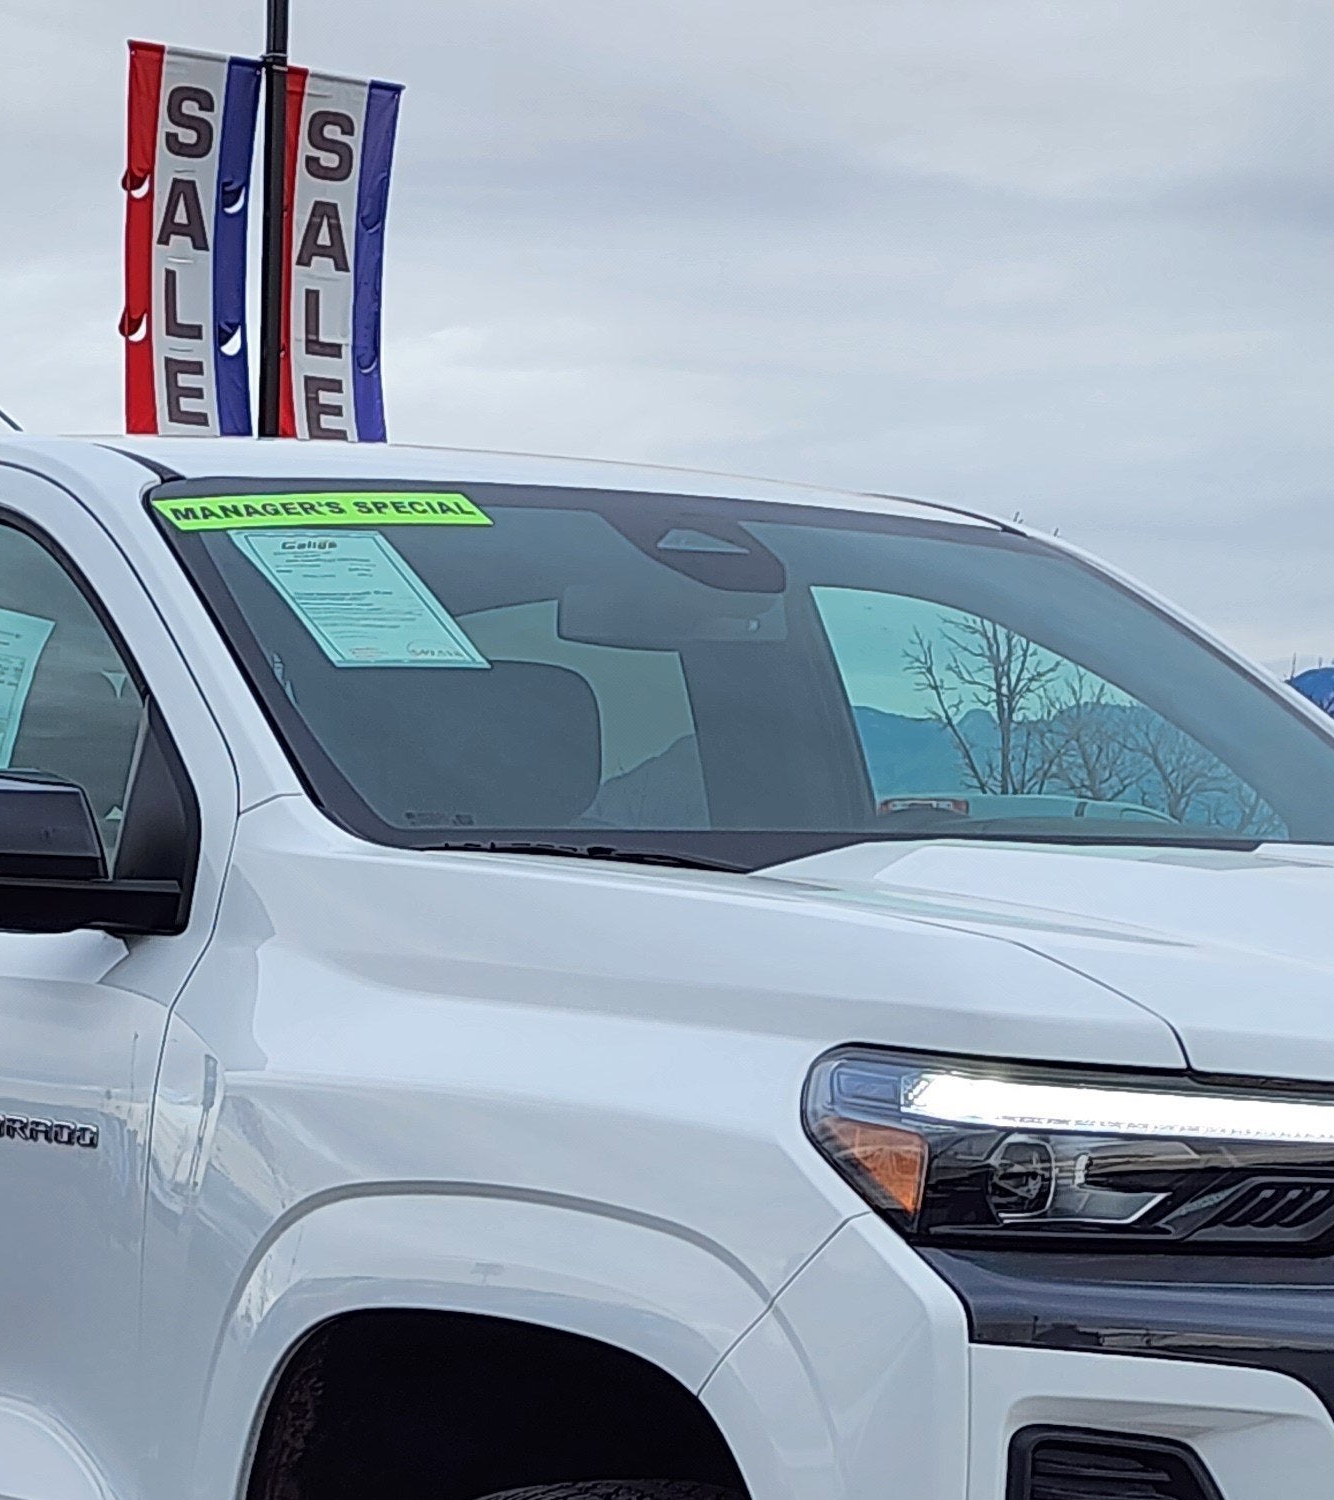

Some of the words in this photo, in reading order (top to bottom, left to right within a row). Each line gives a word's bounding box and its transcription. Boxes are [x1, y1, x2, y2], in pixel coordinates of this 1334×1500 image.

[157, 86, 214, 427] SALE
[295, 110, 355, 441] SALE
[170, 500, 346, 521] MANAGER'S
[357, 500, 475, 517] SPECIAL
